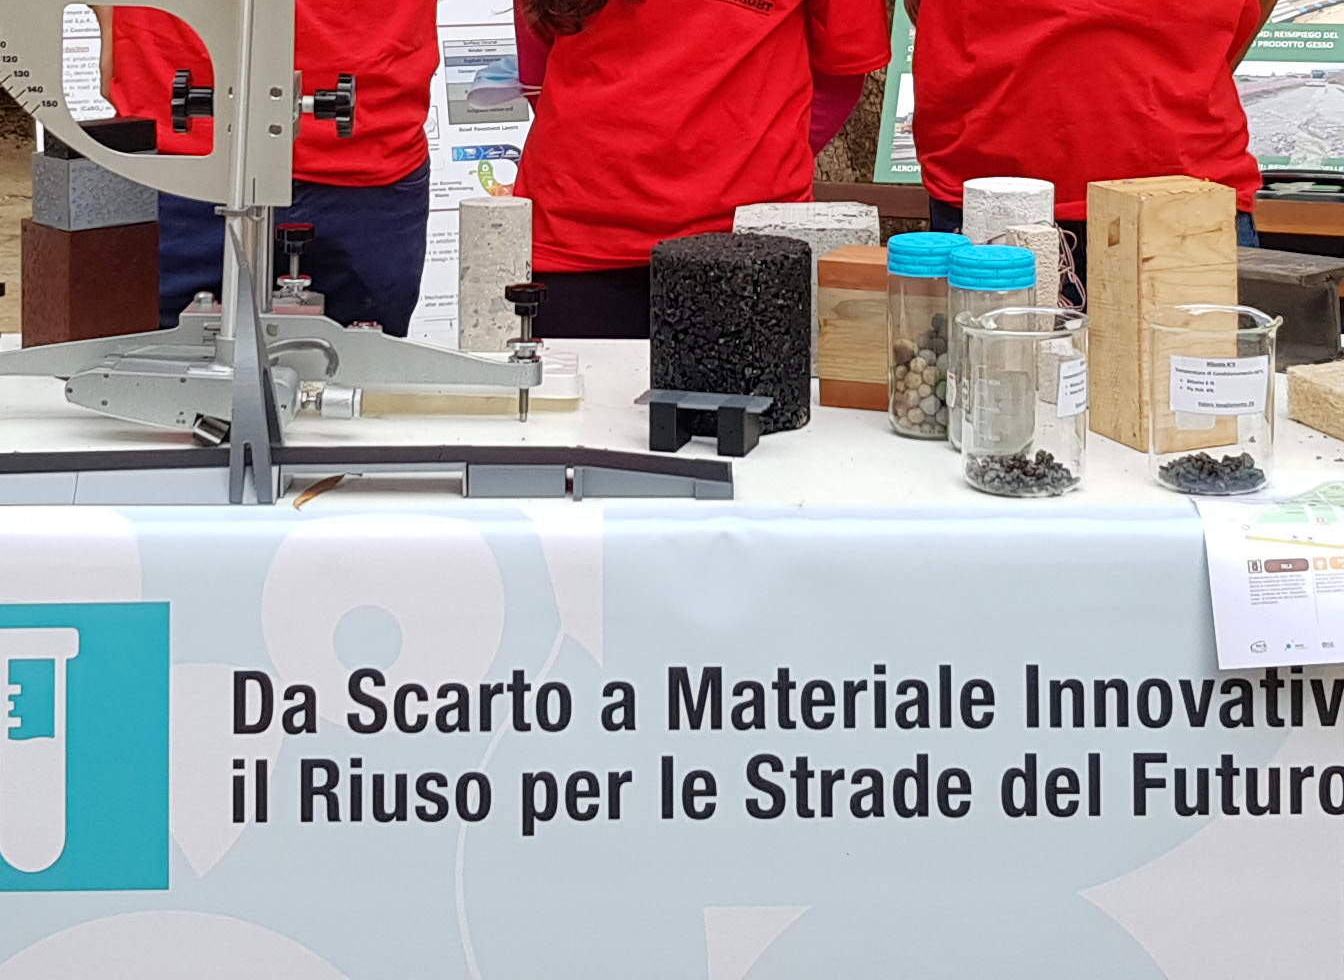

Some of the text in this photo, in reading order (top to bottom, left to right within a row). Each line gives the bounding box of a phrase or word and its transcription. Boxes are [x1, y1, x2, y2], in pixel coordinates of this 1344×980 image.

[233, 669, 318, 734] Da
[347, 668, 573, 734] Scarto
[600, 681, 637, 732] a
[668, 664, 996, 731] Materiale
[232, 758, 269, 824] il
[300, 758, 492, 823] Riuso
[521, 770, 632, 837] per
[661, 755, 718, 820] le
[745, 753, 973, 820] Strade
[1001, 752, 1102, 818] del
